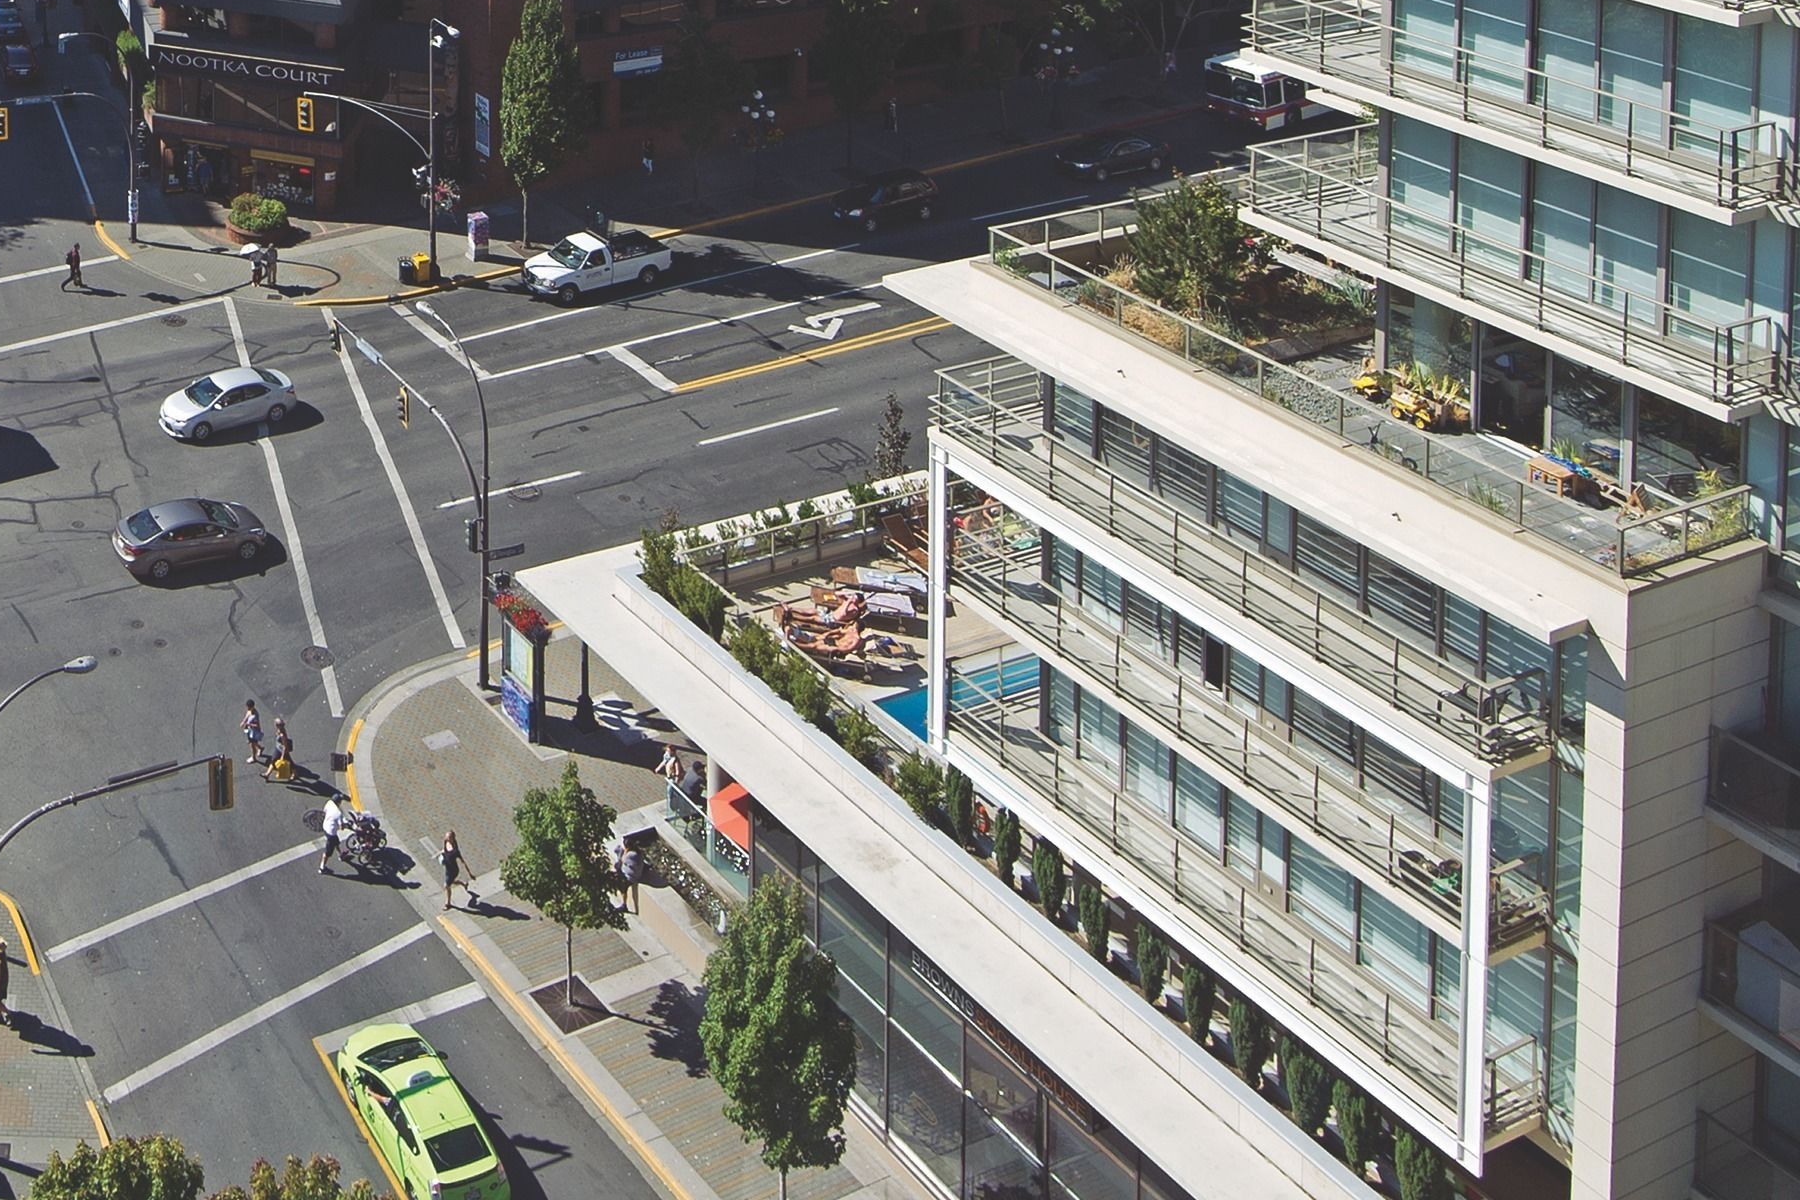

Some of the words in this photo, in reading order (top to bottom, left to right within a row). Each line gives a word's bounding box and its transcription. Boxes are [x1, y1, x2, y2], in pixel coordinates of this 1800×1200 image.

[158, 51, 250, 75] NOOTKA
[255, 64, 333, 85] COURT
[615, 51, 627, 60] For
[627, 50, 648, 58] Lease
[911, 950, 975, 1017] BROWNS
